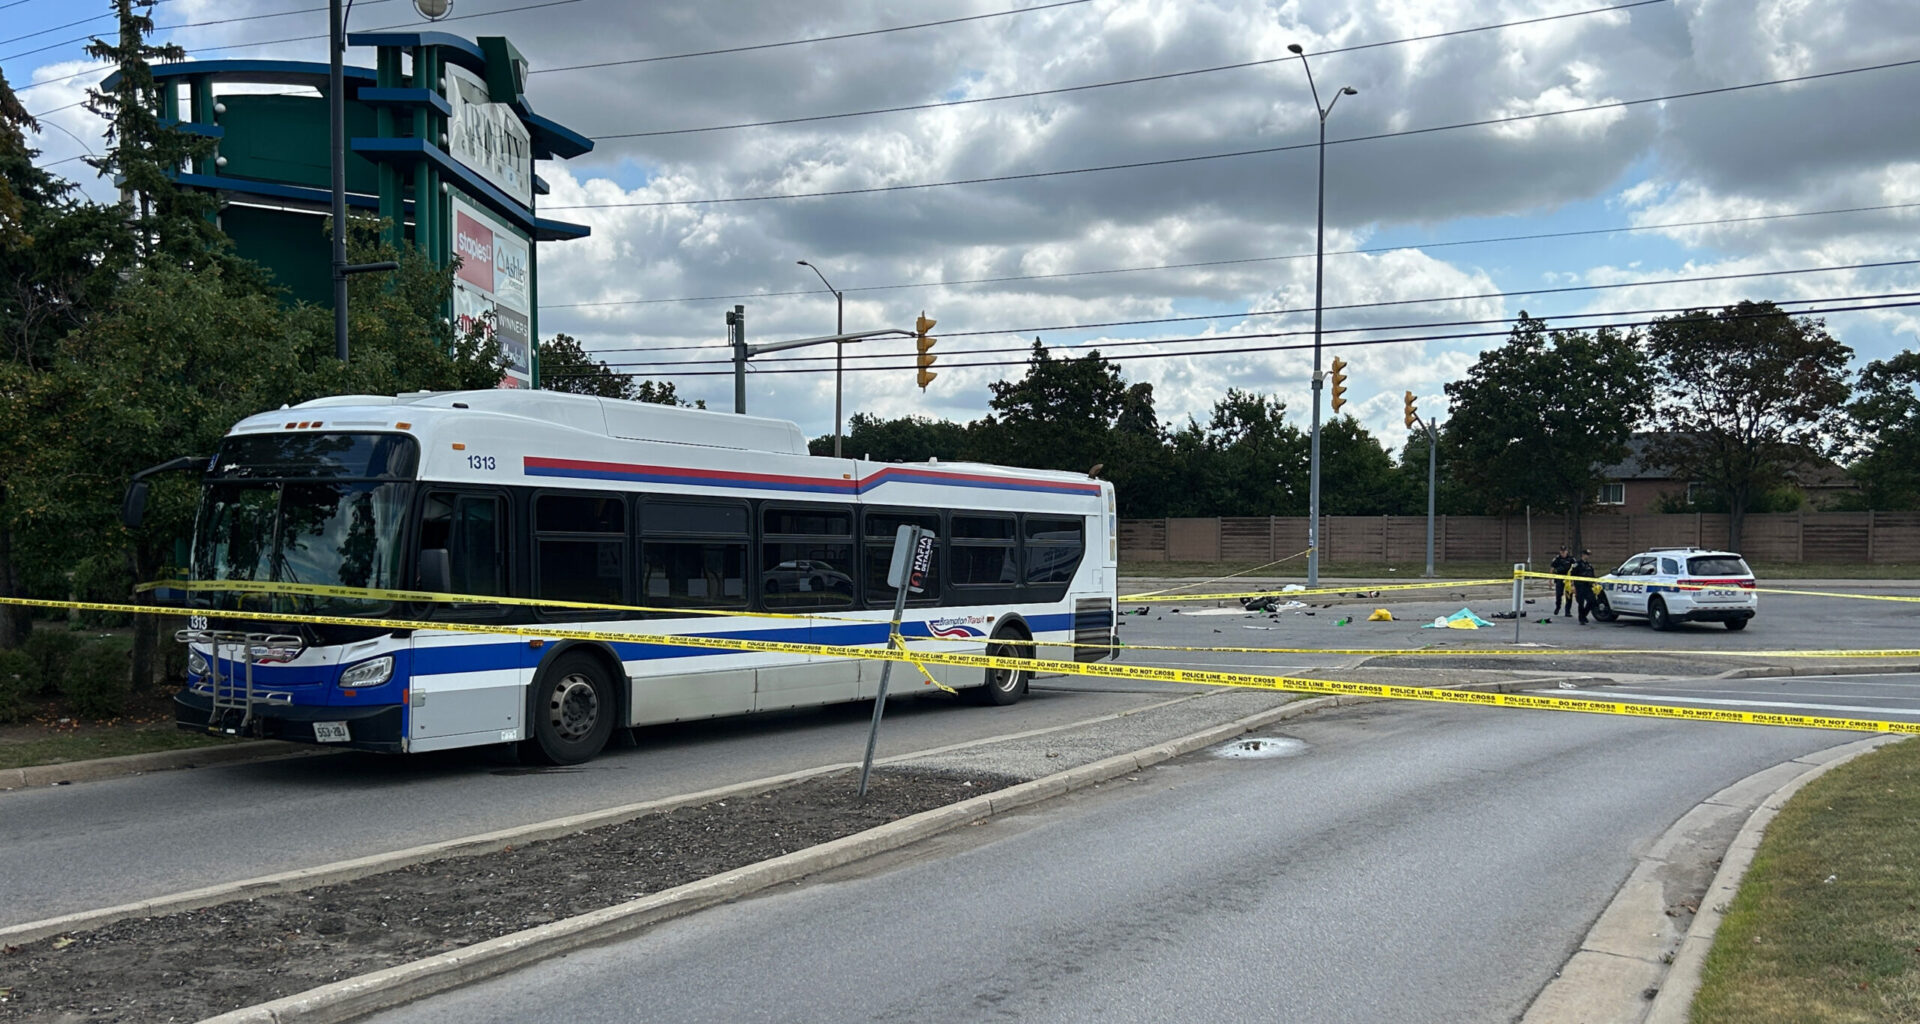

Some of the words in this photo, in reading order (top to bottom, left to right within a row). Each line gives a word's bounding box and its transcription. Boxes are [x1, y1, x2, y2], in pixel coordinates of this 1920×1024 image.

[458, 232, 487, 263] staples
[498, 314, 528, 336] WINNERS
[467, 455, 496, 470] 1313
[914, 538, 928, 571] MAFIA
[1617, 583, 1642, 593] POLICE
[191, 616, 208, 630] 1313
[940, 617, 967, 627] Brampton
[967, 616, 984, 624] Transit
